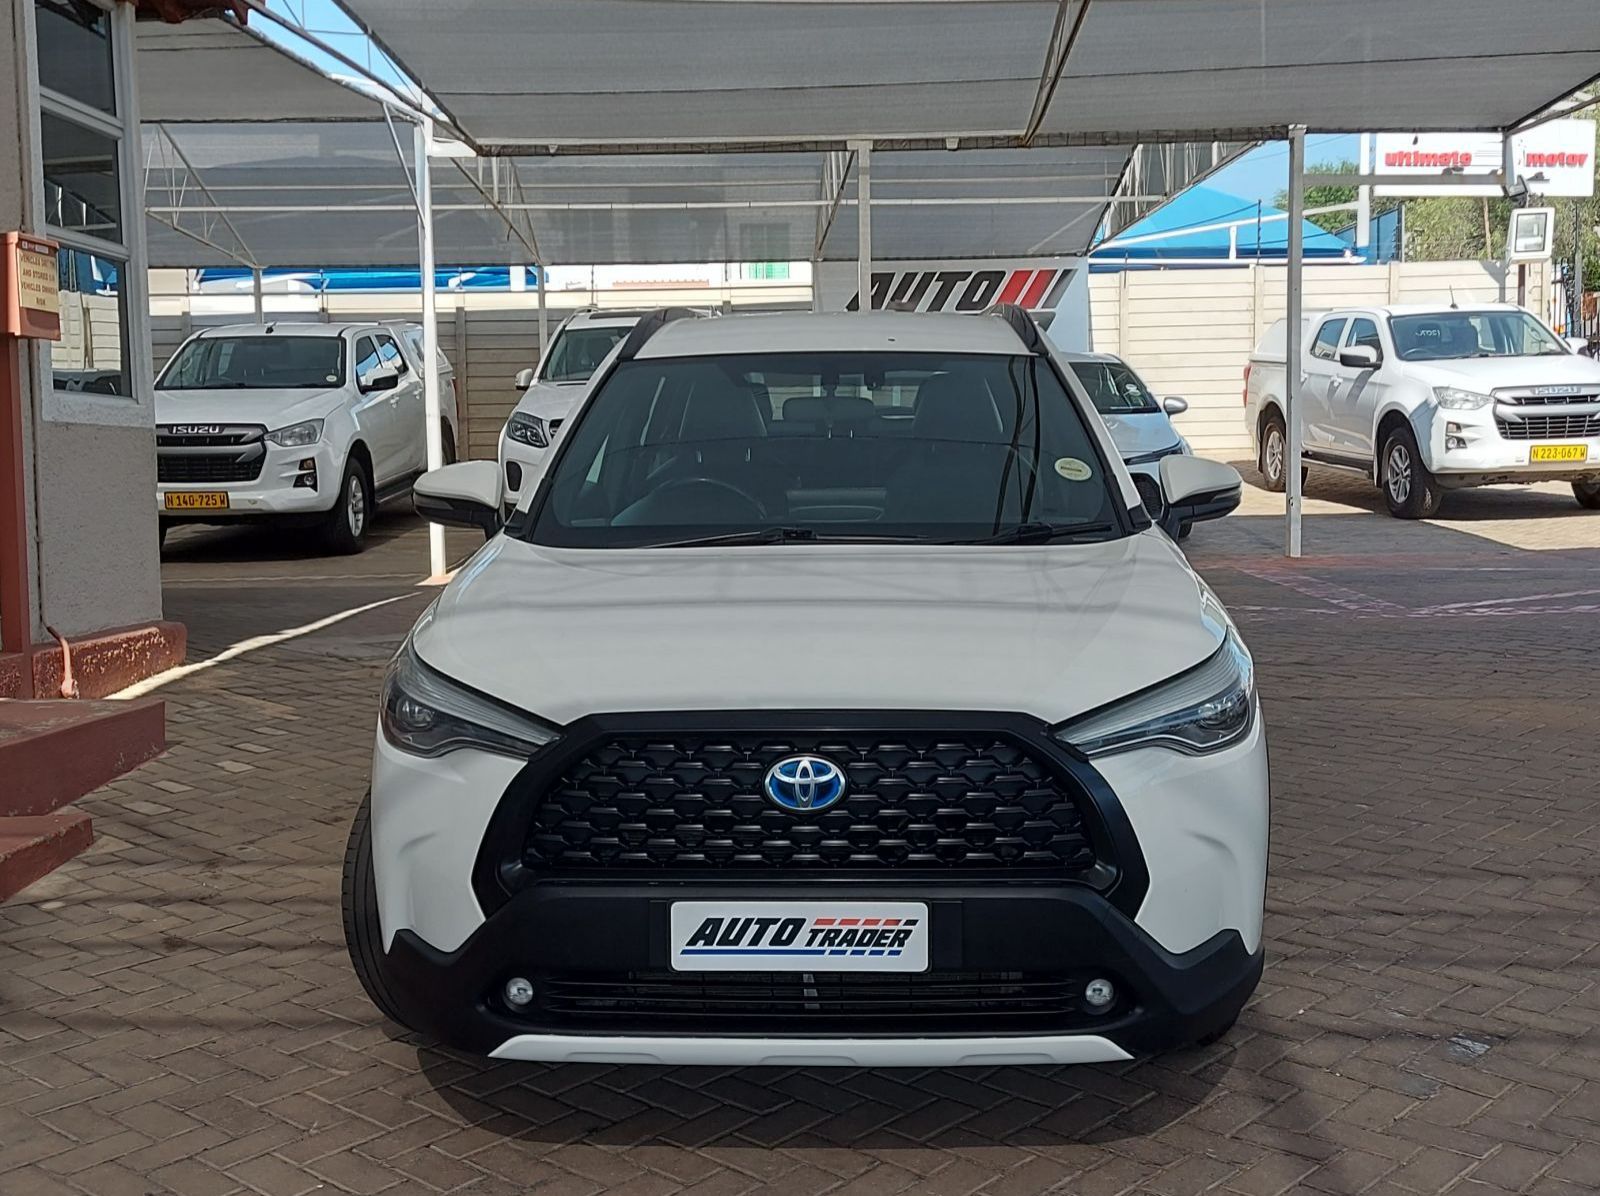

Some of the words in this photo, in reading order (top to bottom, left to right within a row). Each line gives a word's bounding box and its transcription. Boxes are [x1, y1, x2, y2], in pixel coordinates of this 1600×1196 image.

[1526, 151, 1588, 168] motor
[845, 270, 1007, 313] AUTO
[1536, 386, 1577, 395] ISUZU
[173, 425, 219, 434] ISUZU
[1533, 448, 1538, 459] N
[1580, 447, 1586, 458] W
[167, 495, 174, 506] N
[219, 494, 225, 505] W
[685, 918, 807, 947] AUTO
[804, 928, 914, 948] TRADER
